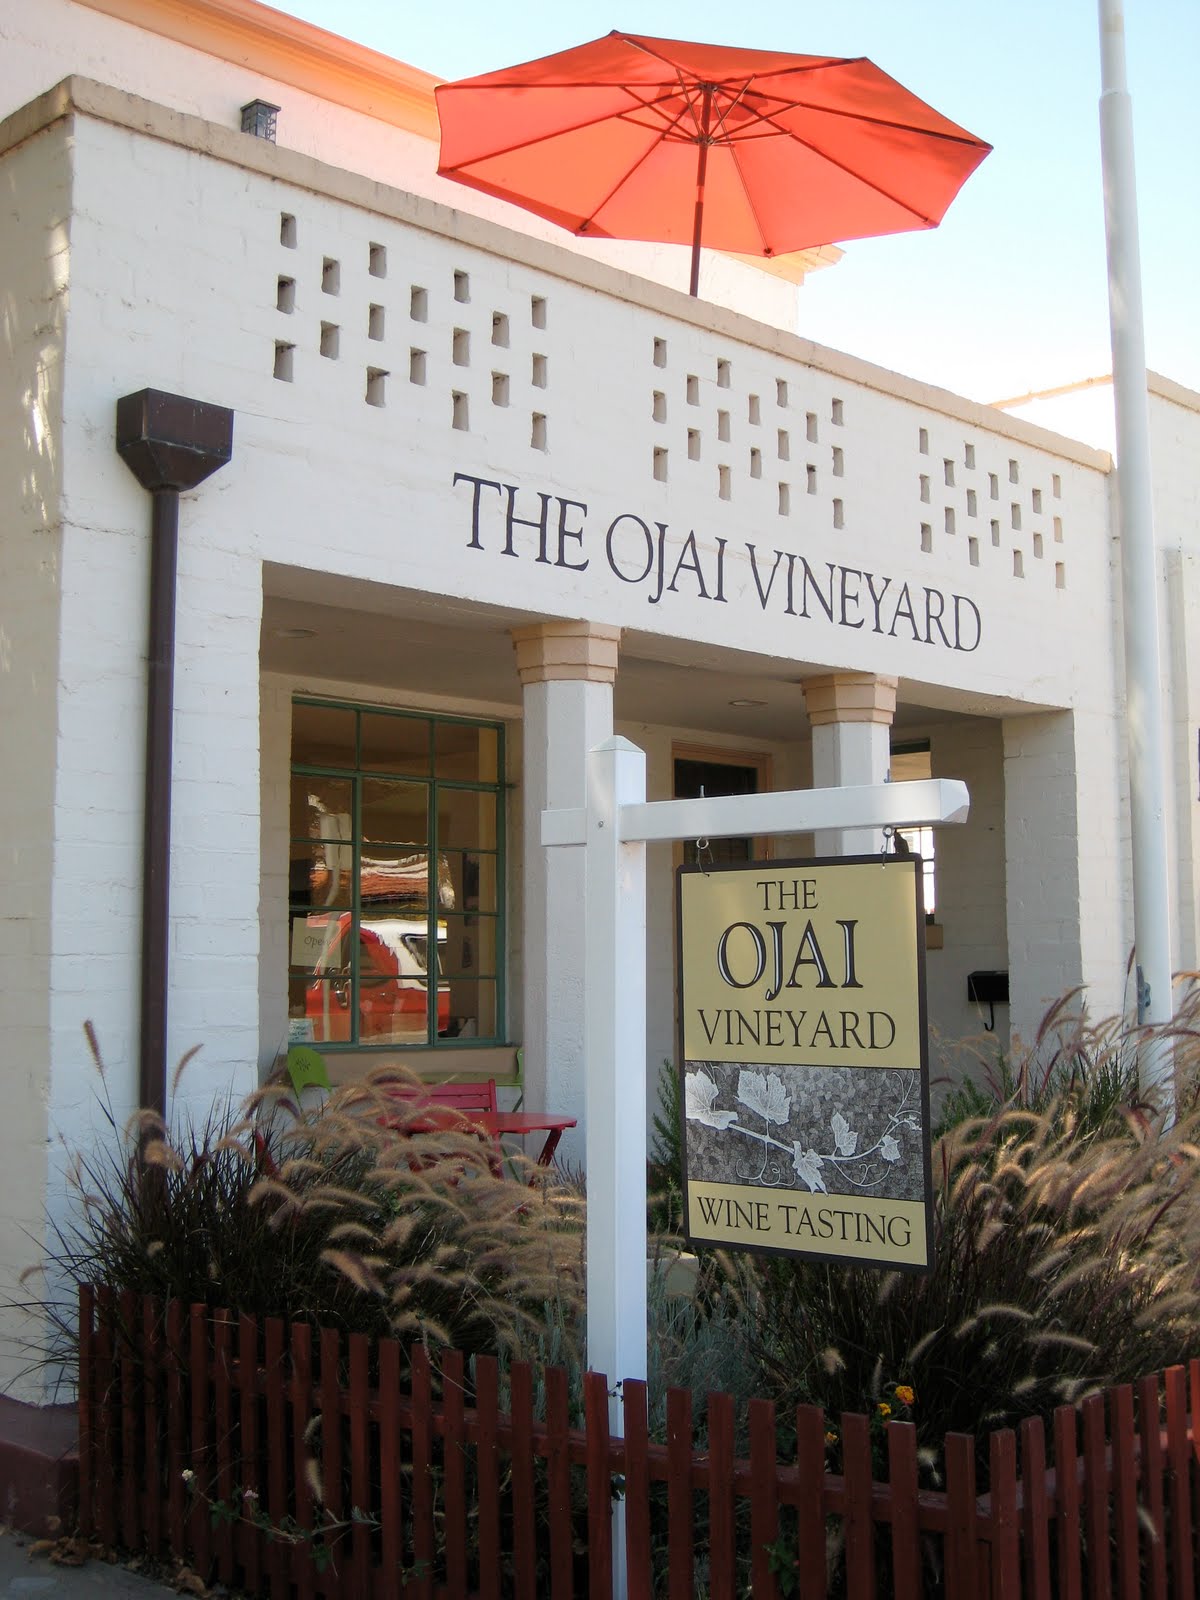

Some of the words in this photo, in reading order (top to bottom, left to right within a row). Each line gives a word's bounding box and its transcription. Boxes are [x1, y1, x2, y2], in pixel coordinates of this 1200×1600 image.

[453, 472, 590, 572] THE
[605, 514, 729, 603] OJAI
[744, 543, 983, 653] VINEYARD
[757, 879, 819, 911] THE
[717, 919, 864, 1001] OJAI
[697, 1008, 897, 1050] VINEYARD
[697, 1195, 771, 1232] WINE
[778, 1204, 912, 1248] TASTING
